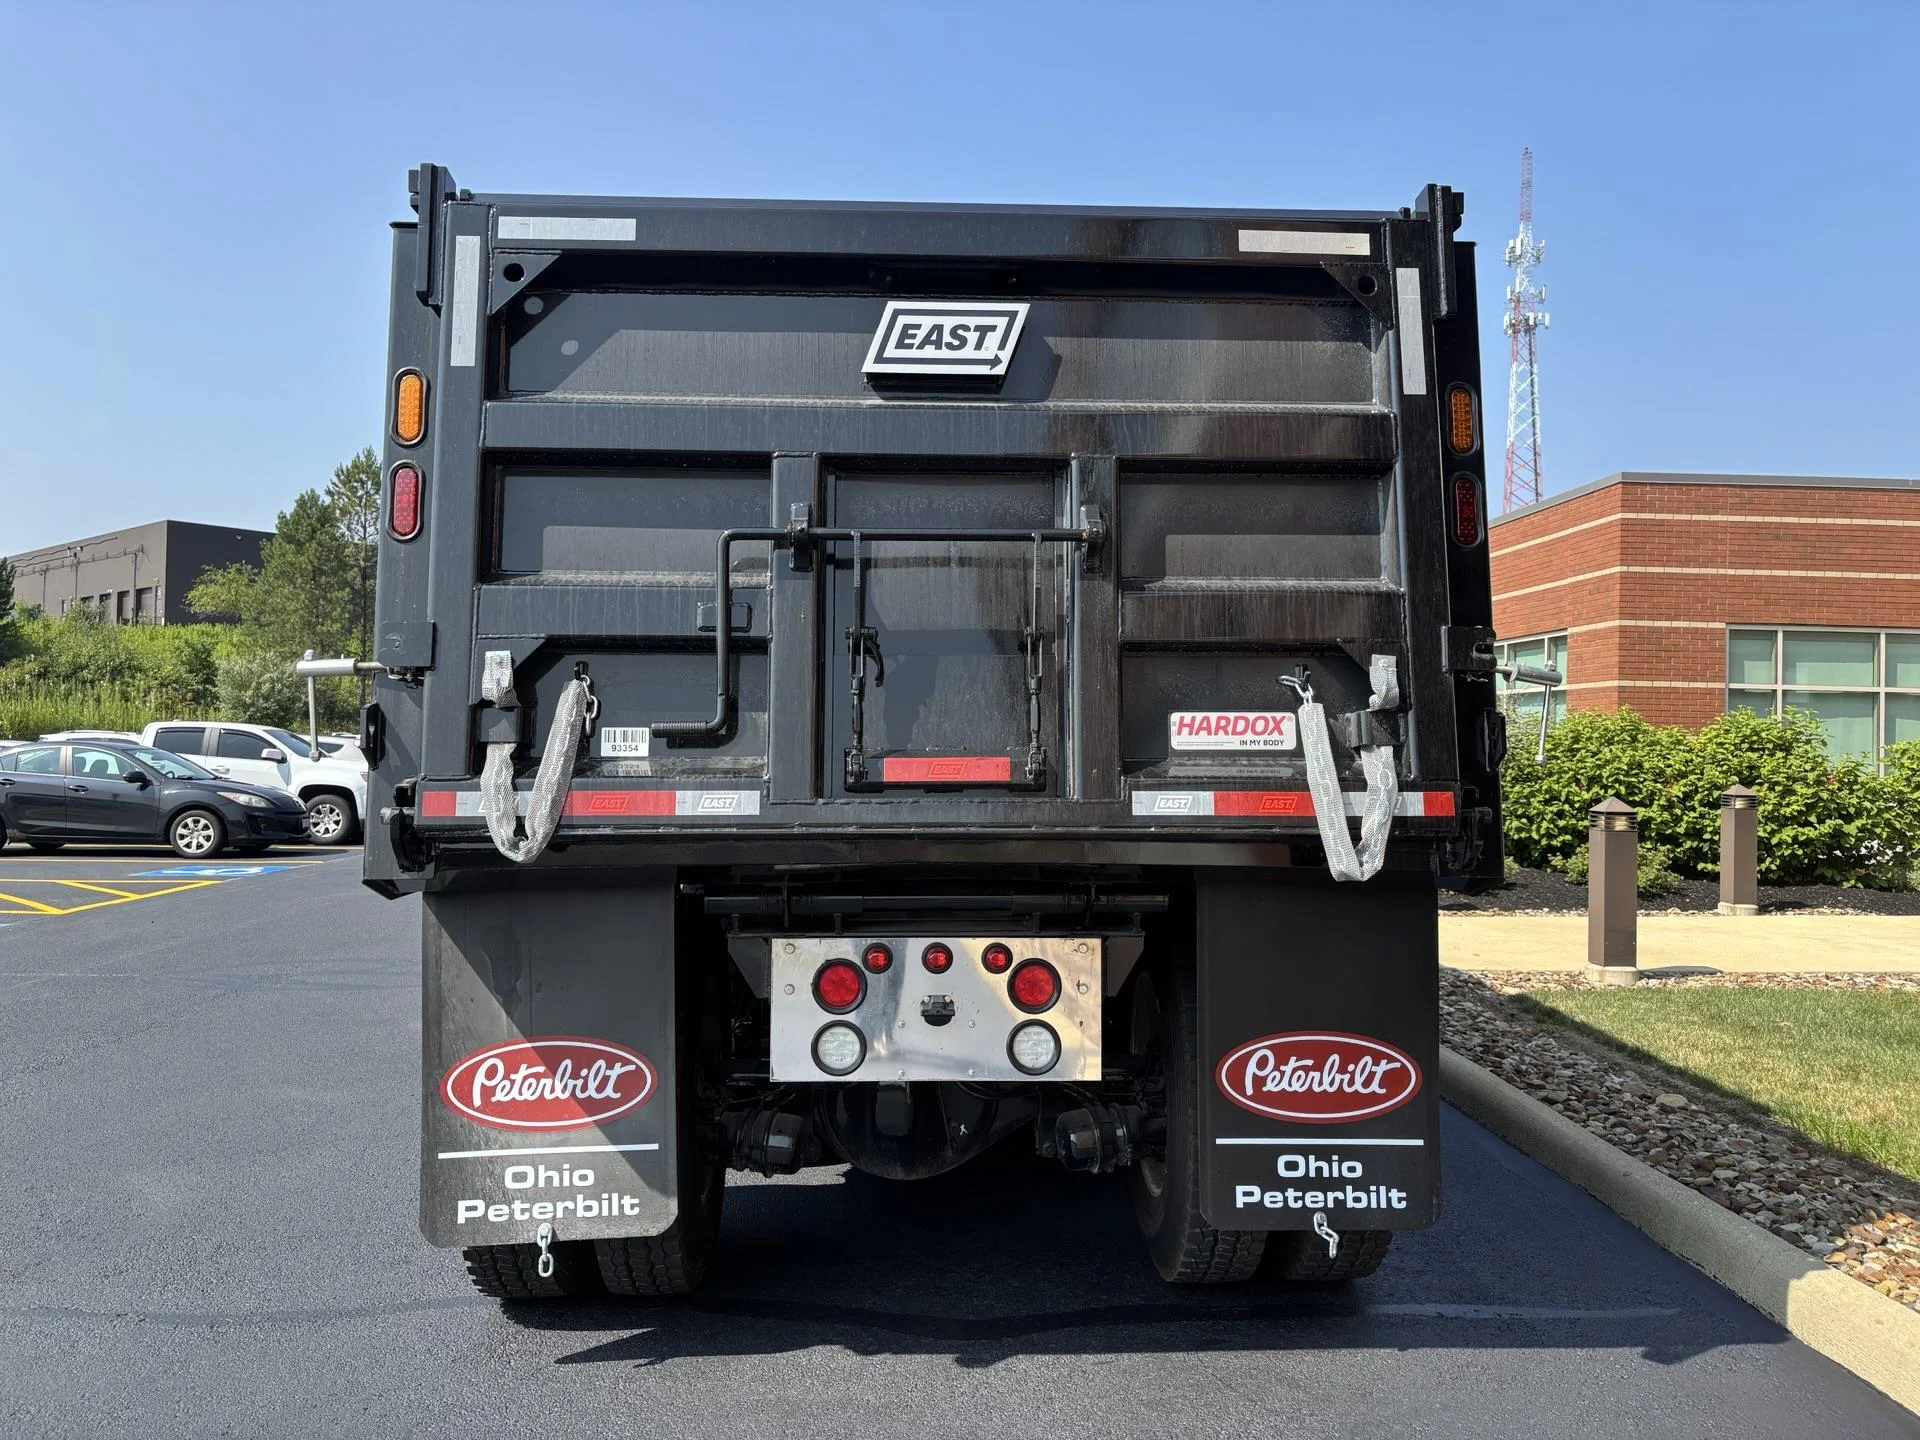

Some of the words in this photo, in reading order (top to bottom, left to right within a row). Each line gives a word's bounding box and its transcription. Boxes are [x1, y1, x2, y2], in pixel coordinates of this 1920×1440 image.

[894, 323, 998, 351] EAST
[611, 744, 639, 752] 93354
[1239, 739, 1248, 747] IN
[1249, 739, 1261, 747] MY
[1263, 739, 1285, 747] BODY
[934, 766, 961, 774] EAST
[594, 798, 624, 808] EAST
[703, 798, 733, 808] EAST
[1159, 799, 1188, 809] EAST
[1264, 799, 1293, 809] EAST
[1244, 1048, 1401, 1096] Peterbilt
[472, 1057, 637, 1108] Peterbilt
[1277, 1154, 1363, 1178] Ohio
[504, 1164, 595, 1190] Ohio
[1235, 1185, 1407, 1209] Peterbilt
[457, 1192, 640, 1224] Peterbilt
